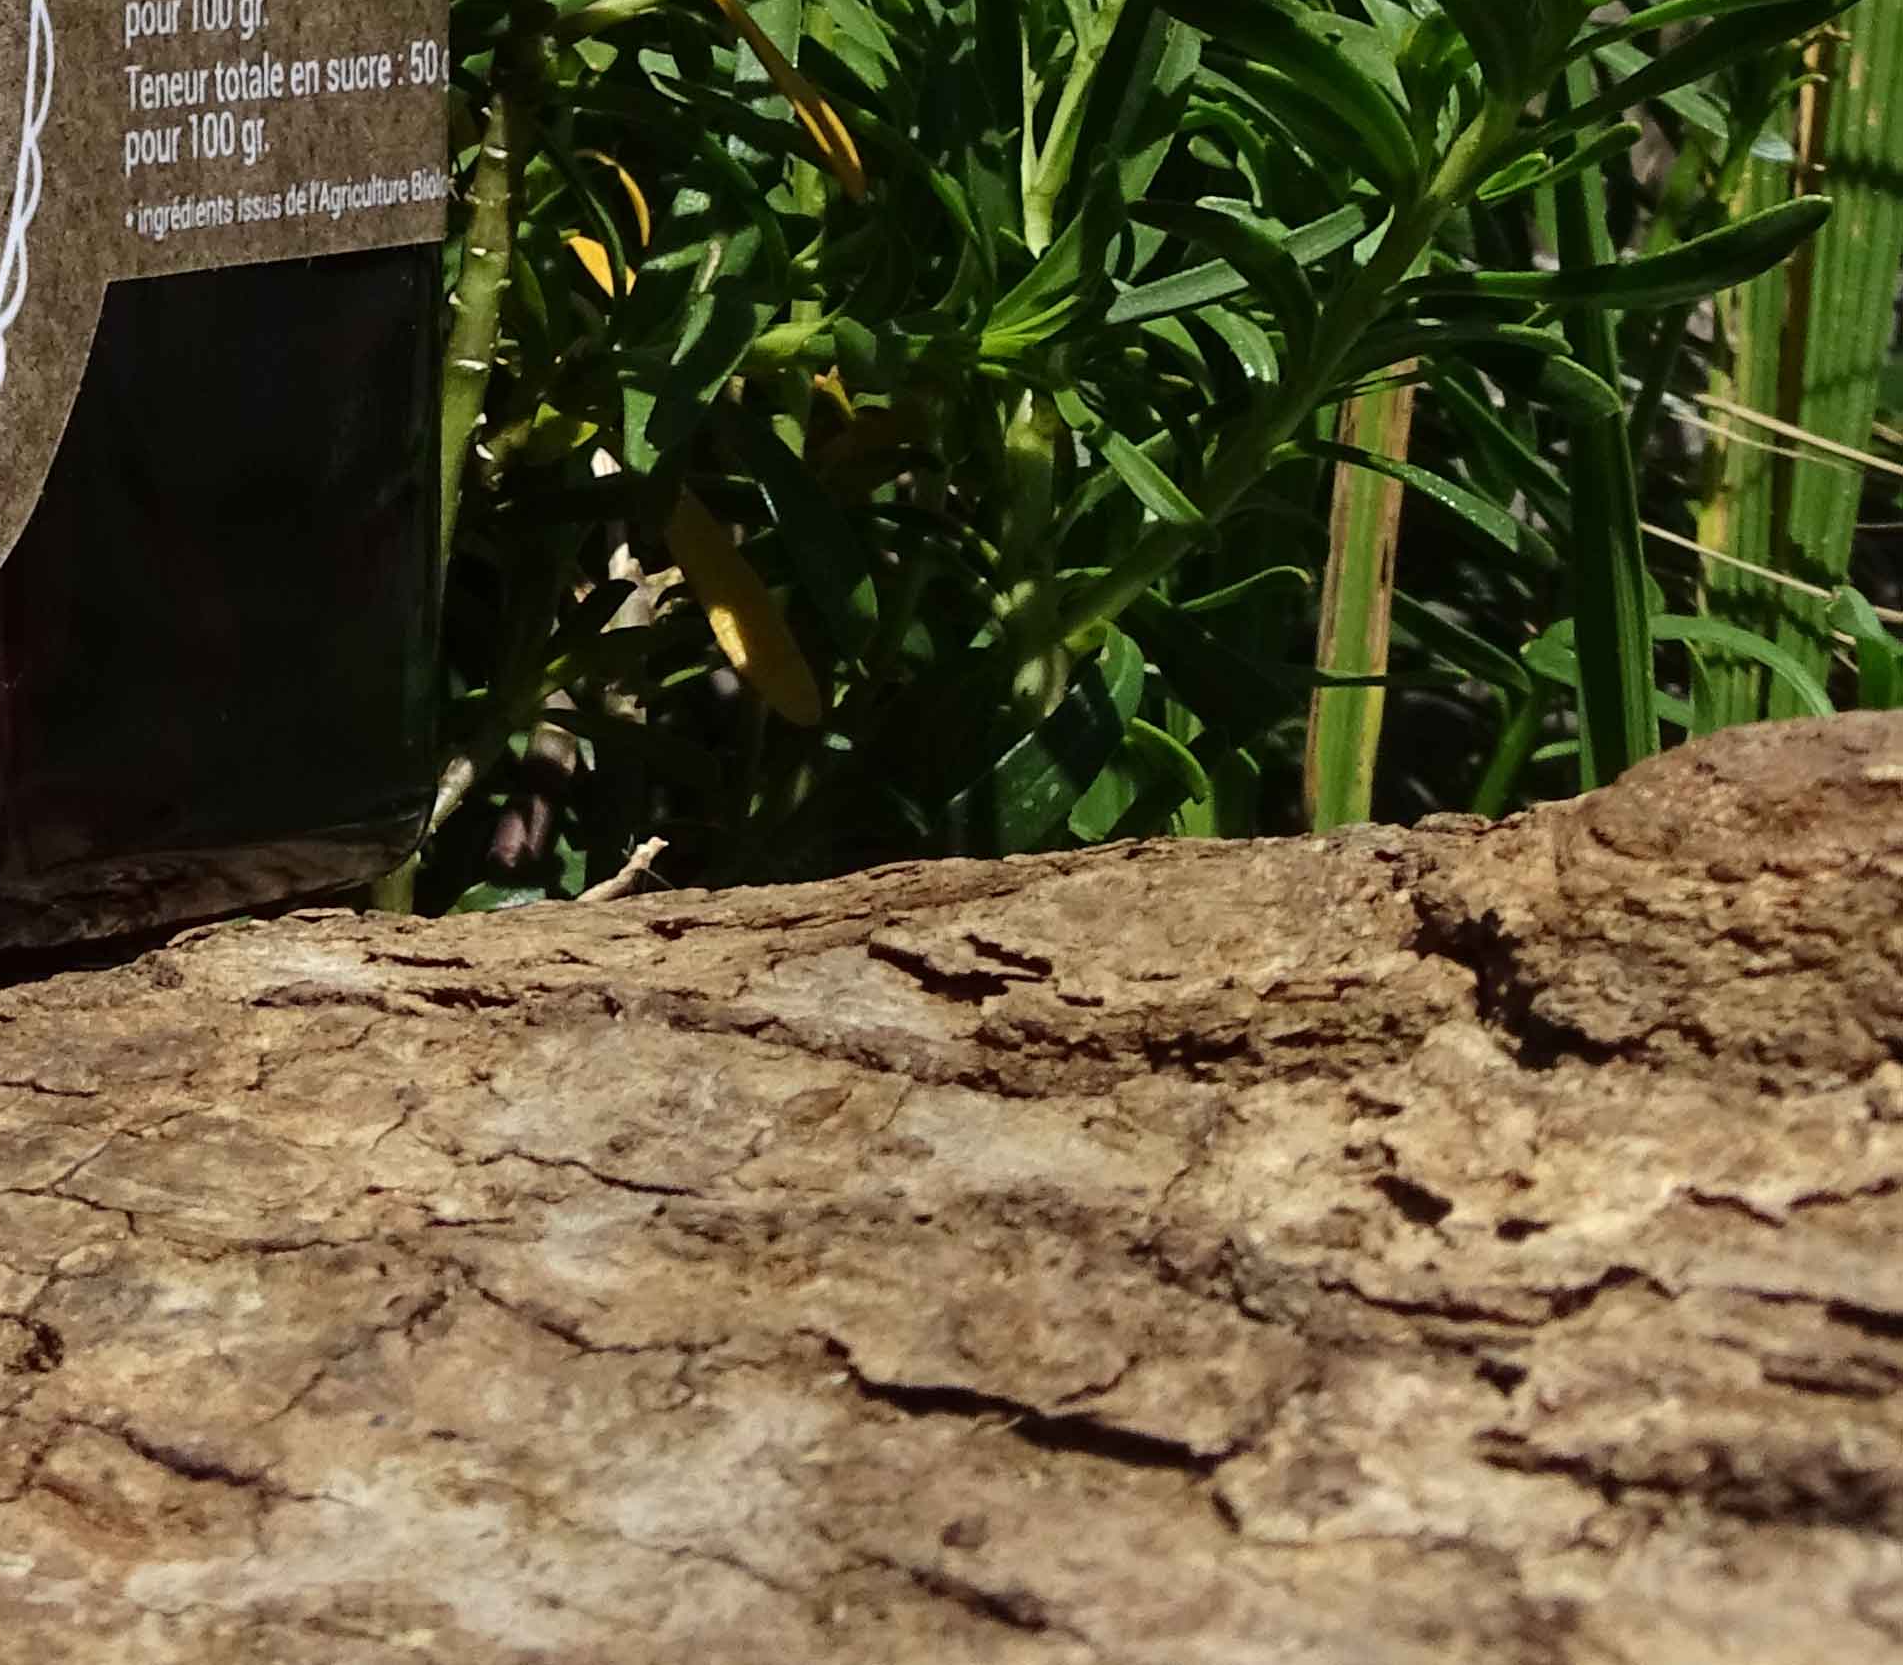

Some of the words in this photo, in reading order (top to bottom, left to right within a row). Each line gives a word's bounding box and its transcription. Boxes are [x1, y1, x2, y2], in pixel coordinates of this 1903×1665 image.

[124, 65, 208, 111] Teneur
[215, 51, 284, 103] totale
[290, 58, 320, 96] en
[326, 53, 392, 93] sucre
[410, 39, 438, 85] 50
[124, 126, 182, 178] pour
[189, 112, 236, 159] 100
[241, 117, 270, 166] gr.
[237, 190, 282, 223] issus
